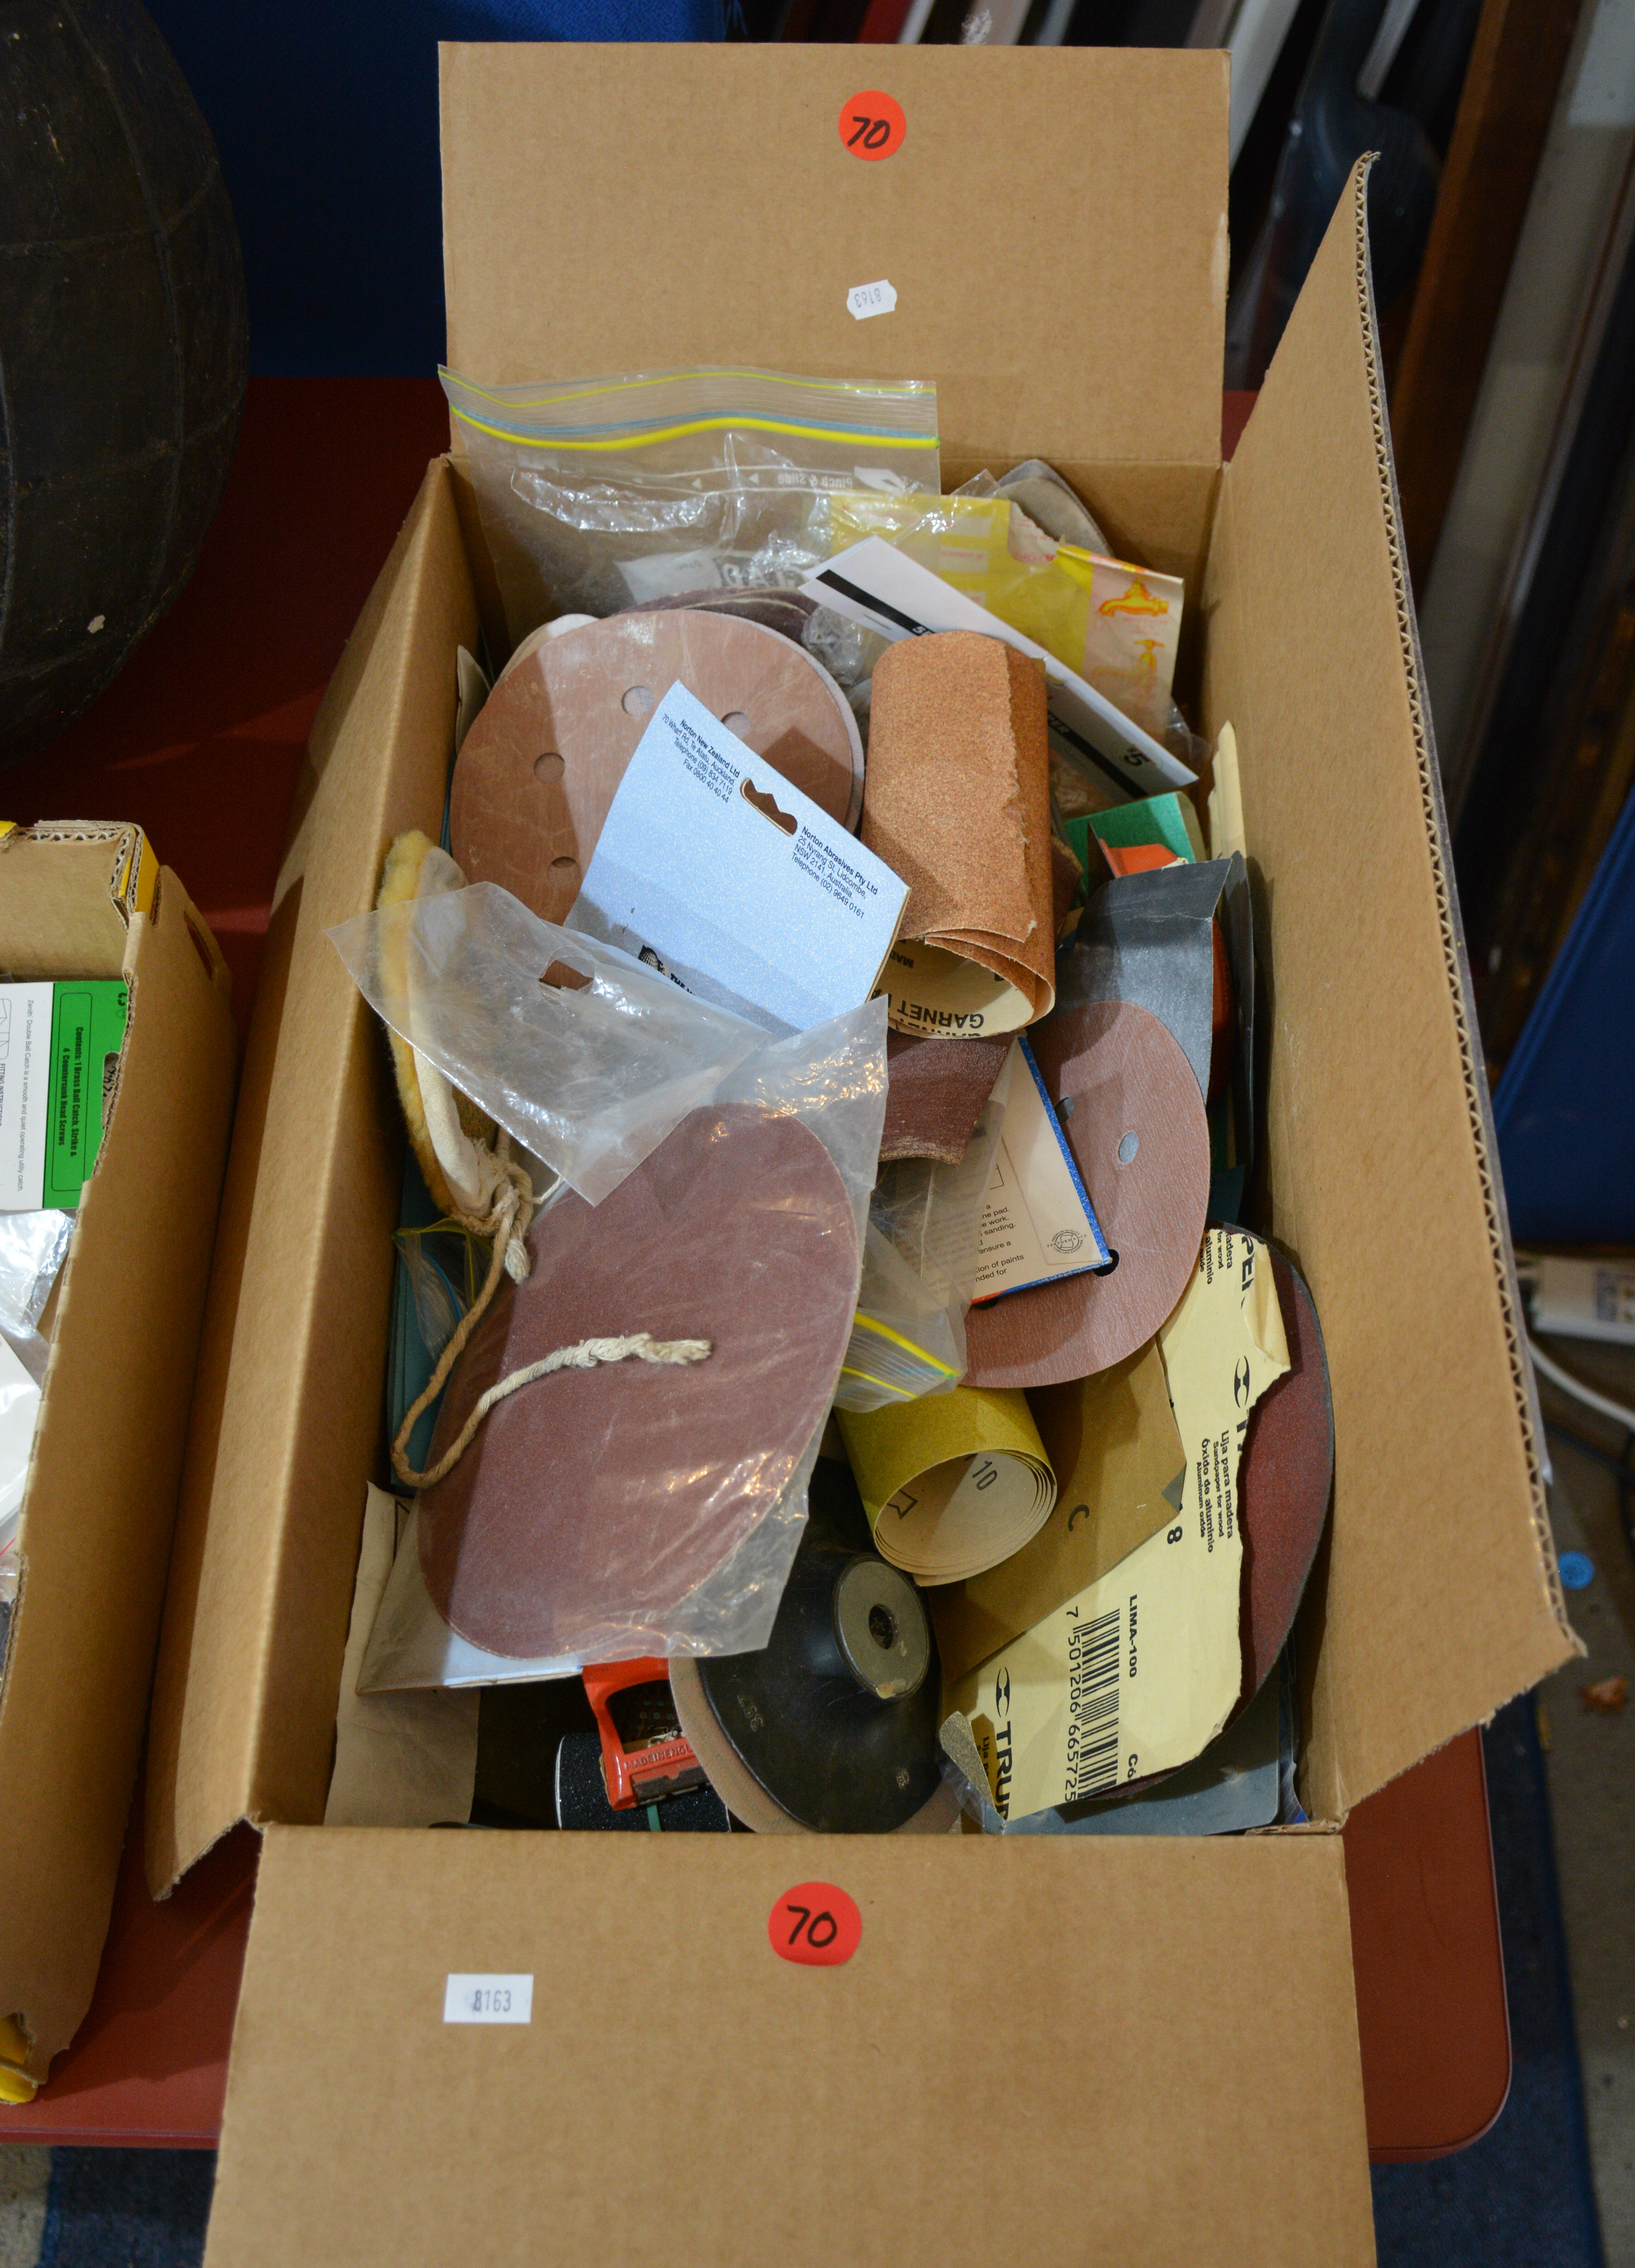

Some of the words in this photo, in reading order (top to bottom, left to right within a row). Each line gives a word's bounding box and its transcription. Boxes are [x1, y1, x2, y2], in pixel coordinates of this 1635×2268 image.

[848, 116, 890, 149] 70
[854, 288, 882, 308] 8163
[662, 713, 669, 723] 70
[668, 719, 682, 736] Wharf
[690, 740, 696, 750] Te
[680, 719, 696, 739] Norton
[697, 735, 708, 749] New
[708, 747, 730, 769] Zealand
[730, 765, 740, 778] Ltd
[673, 737, 697, 764] Telephone
[698, 760, 708, 774] (09)
[709, 770, 719, 782] 834
[719, 779, 732, 795] 7119
[683, 758, 693, 772] Fax
[693, 768, 707, 783] 0800
[707, 781, 714, 790] 40
[714, 787, 721, 796] 40
[721, 794, 729, 803] 44
[795, 844, 811, 860] NSW
[827, 872, 853, 899] Australia.
[798, 836, 807, 846] 25
[807, 842, 827, 865] Nyrang
[828, 860, 836, 873] St,
[837, 868, 866, 899] Lidcombe,
[802, 826, 823, 848] Norton
[824, 846, 854, 875] Abrasives
[855, 871, 866, 885] Pty
[866, 882, 878, 895] Ltd
[792, 852, 820, 881] Telephone
[820, 878, 833, 893] (02)
[833, 889, 849, 905] 9649
[849, 903, 864, 919] 0161
[897, 1000, 984, 1029] GARNET
[75, 1027, 84, 1061] Contents:
[61, 1055, 70, 1099] Countersunk
[74, 1067, 82, 1087] Brass
[58, 1120, 67, 1146] Screws
[71, 1128, 79, 1150] Strike
[989, 1216, 1009, 1226] work.
[994, 1206, 1010, 1217] pad.
[984, 1222, 1016, 1236] sanding.
[1047, 1234, 1087, 1247] PERFORMANCE
[979, 1243, 1004, 1254] ensure
[1001, 1254, 1024, 1266] paints
[1205, 1236, 1214, 1284] aluminio
[996, 1268, 1007, 1277] for
[1202, 1438, 1211, 1476] Óxido
[1220, 1430, 1229, 1454] Lija
[1204, 1479, 1211, 1495] de
[1221, 1457, 1230, 1487] para
[1205, 1498, 1215, 1553] aluminio
[1225, 1489, 1234, 1539] madera
[1066, 1606, 1079, 1618] 7
[1129, 1594, 1137, 1678] LIMA-100
[1068, 1634, 1081, 1714] 501206
[787, 1905, 838, 1947] 70
[472, 1990, 511, 2012] 8163
